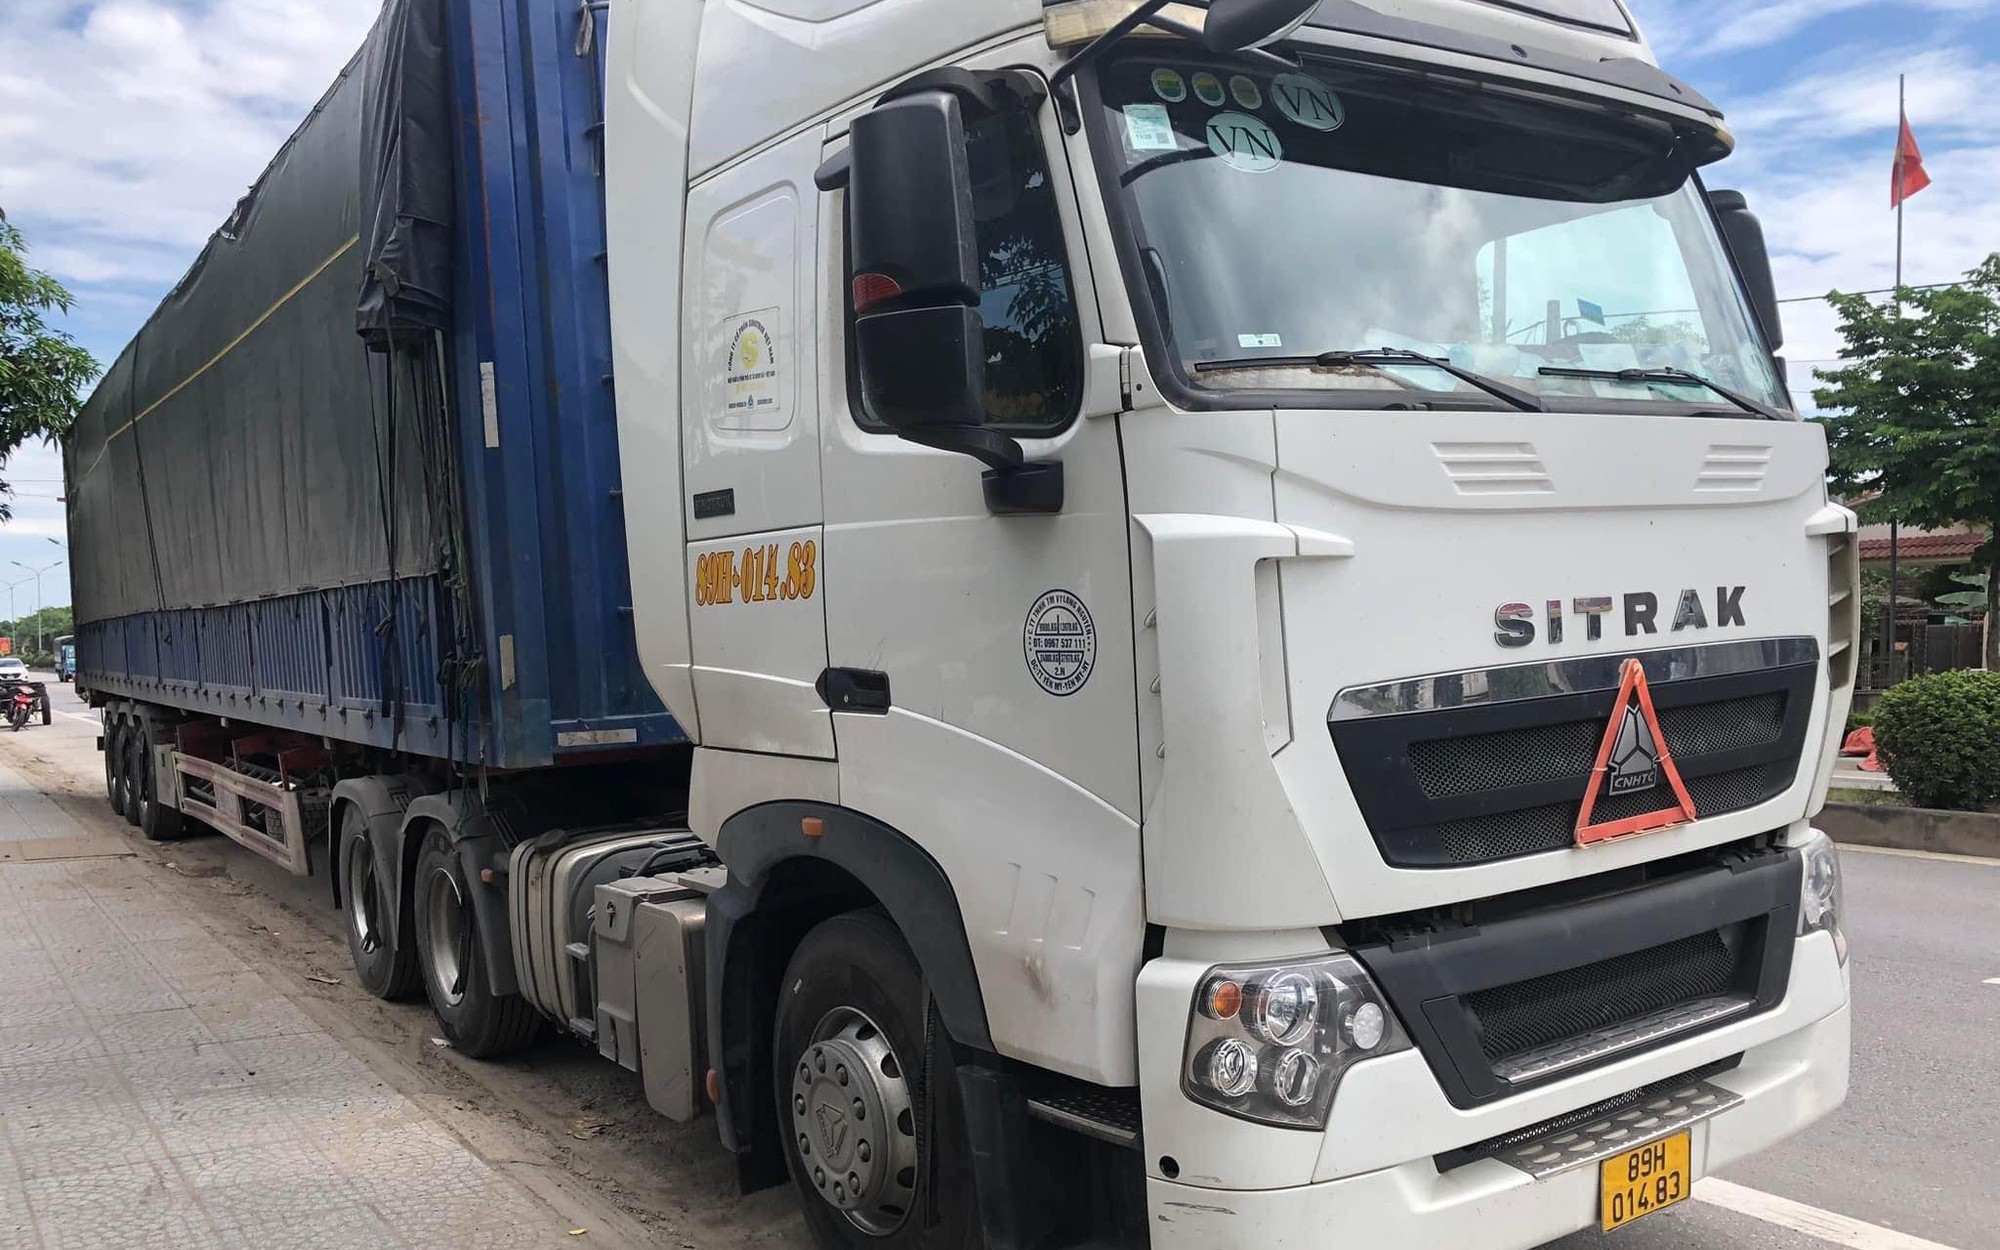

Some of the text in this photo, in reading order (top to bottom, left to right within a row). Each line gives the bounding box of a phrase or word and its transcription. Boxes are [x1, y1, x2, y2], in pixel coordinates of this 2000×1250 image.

[1274, 83, 1338, 122] VN
[1208, 124, 1277, 161] VN
[1033, 602, 1046, 618] TNHH
[1494, 586, 1746, 648] SITRAK
[1074, 638, 1086, 649] 111
[1614, 771, 1655, 789] CNHTC
[1628, 1143, 1666, 1182] 89H
[1612, 1171, 1681, 1223] 014.83
